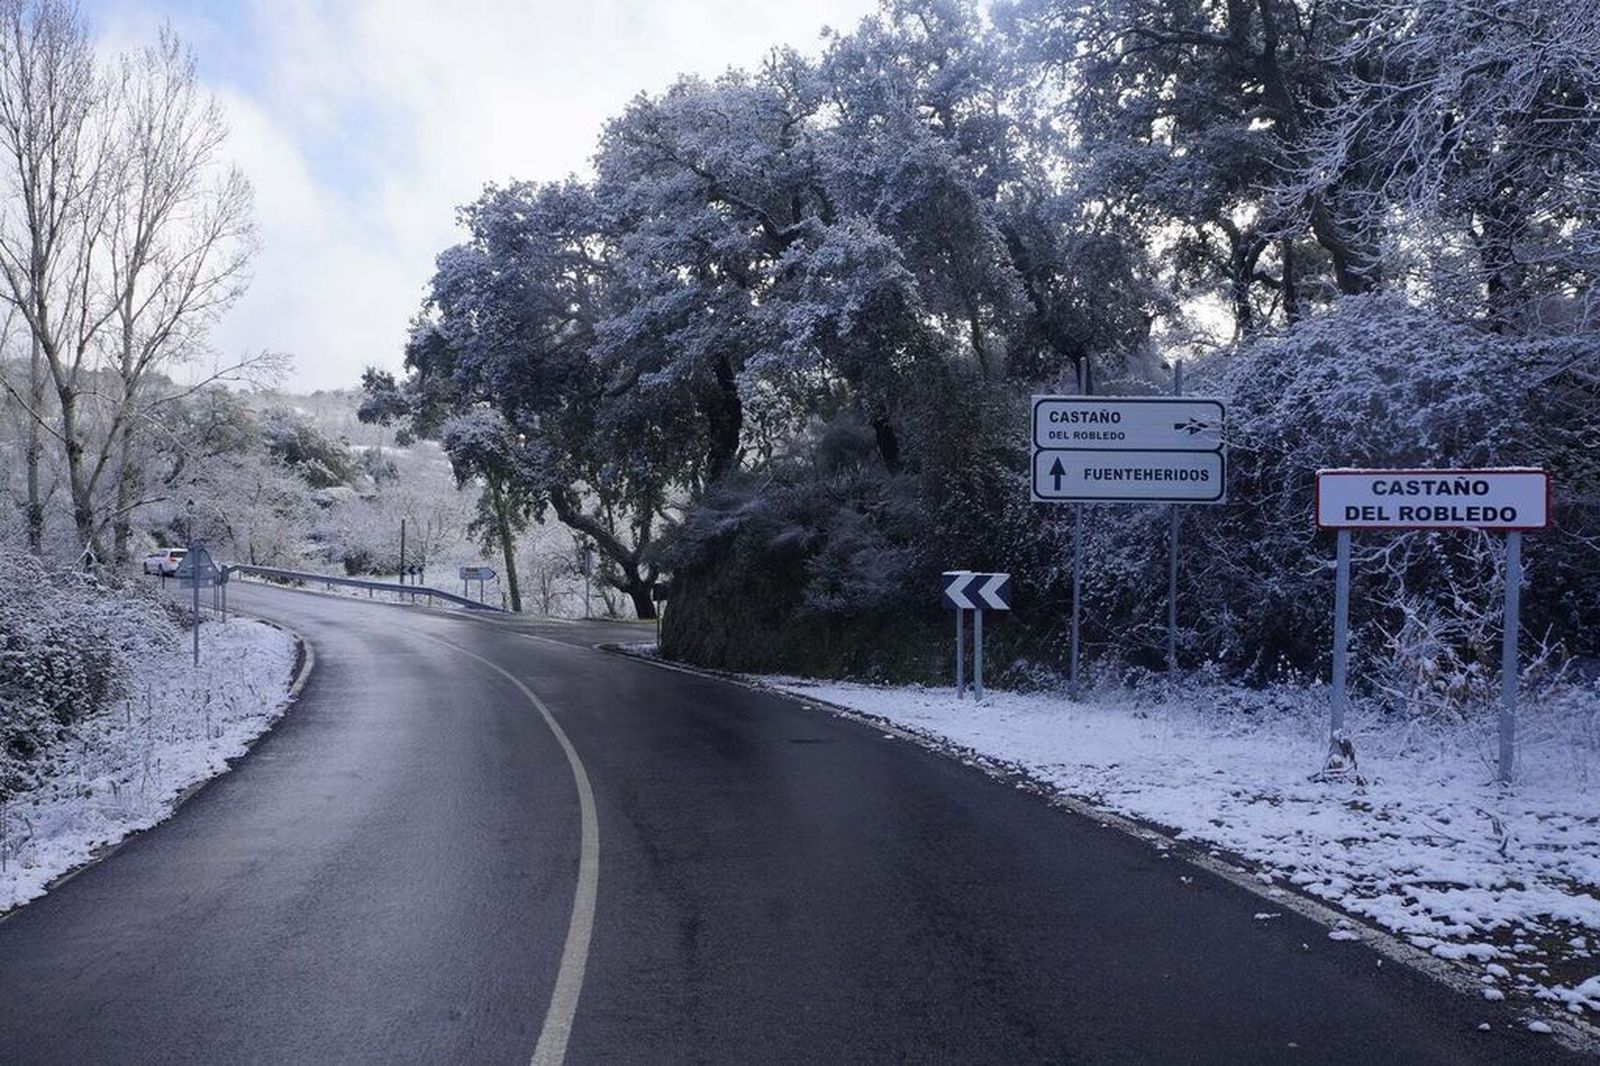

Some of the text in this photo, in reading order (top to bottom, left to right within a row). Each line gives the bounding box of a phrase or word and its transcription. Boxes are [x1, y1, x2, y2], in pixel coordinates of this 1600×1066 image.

[1049, 409, 1121, 424] CASTAÑO
[1049, 431, 1125, 441] DEL ROBLEDO
[1084, 468, 1209, 482] FUENTEHERIDOS
[1371, 476, 1490, 496] CASTAÑO
[1345, 506, 1517, 522] DEL ROBLEDO
